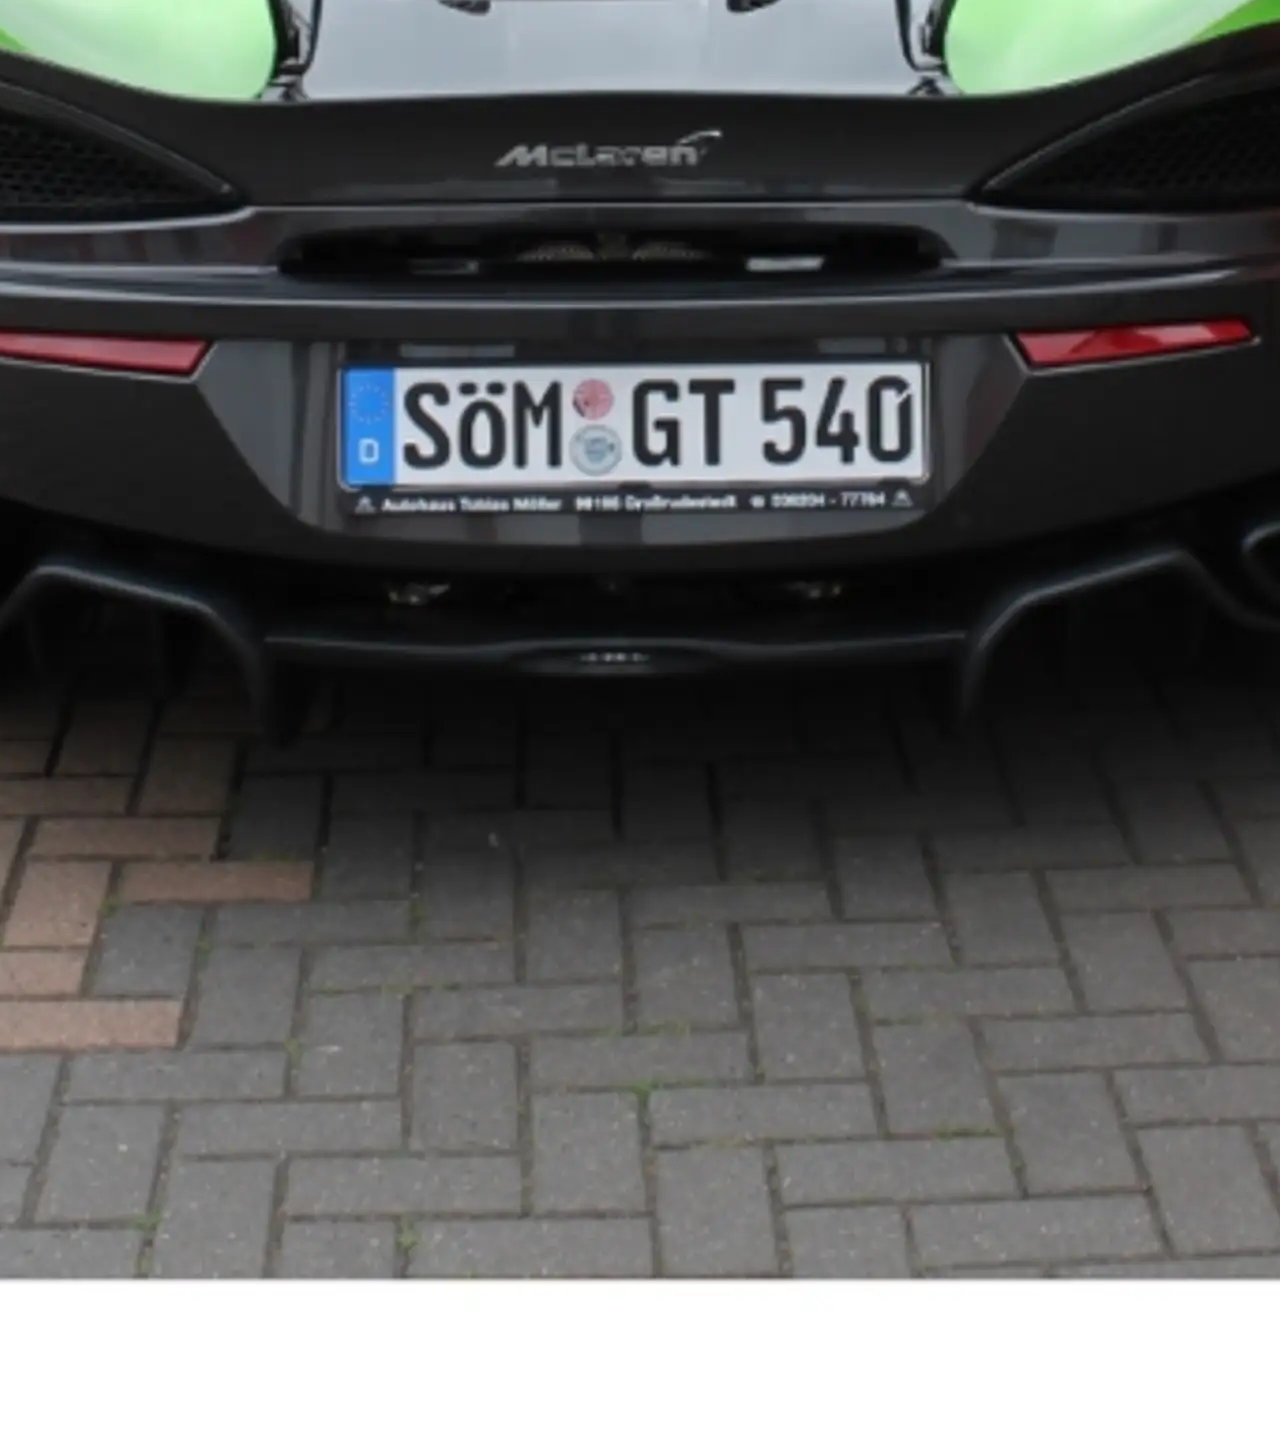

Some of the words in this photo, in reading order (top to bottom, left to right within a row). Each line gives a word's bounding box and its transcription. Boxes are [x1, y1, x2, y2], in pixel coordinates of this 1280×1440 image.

[494, 140, 700, 167] McLaren
[403, 381, 562, 469] SÖM
[633, 379, 735, 467] GT
[760, 376, 913, 465] 540
[358, 439, 379, 464] D
